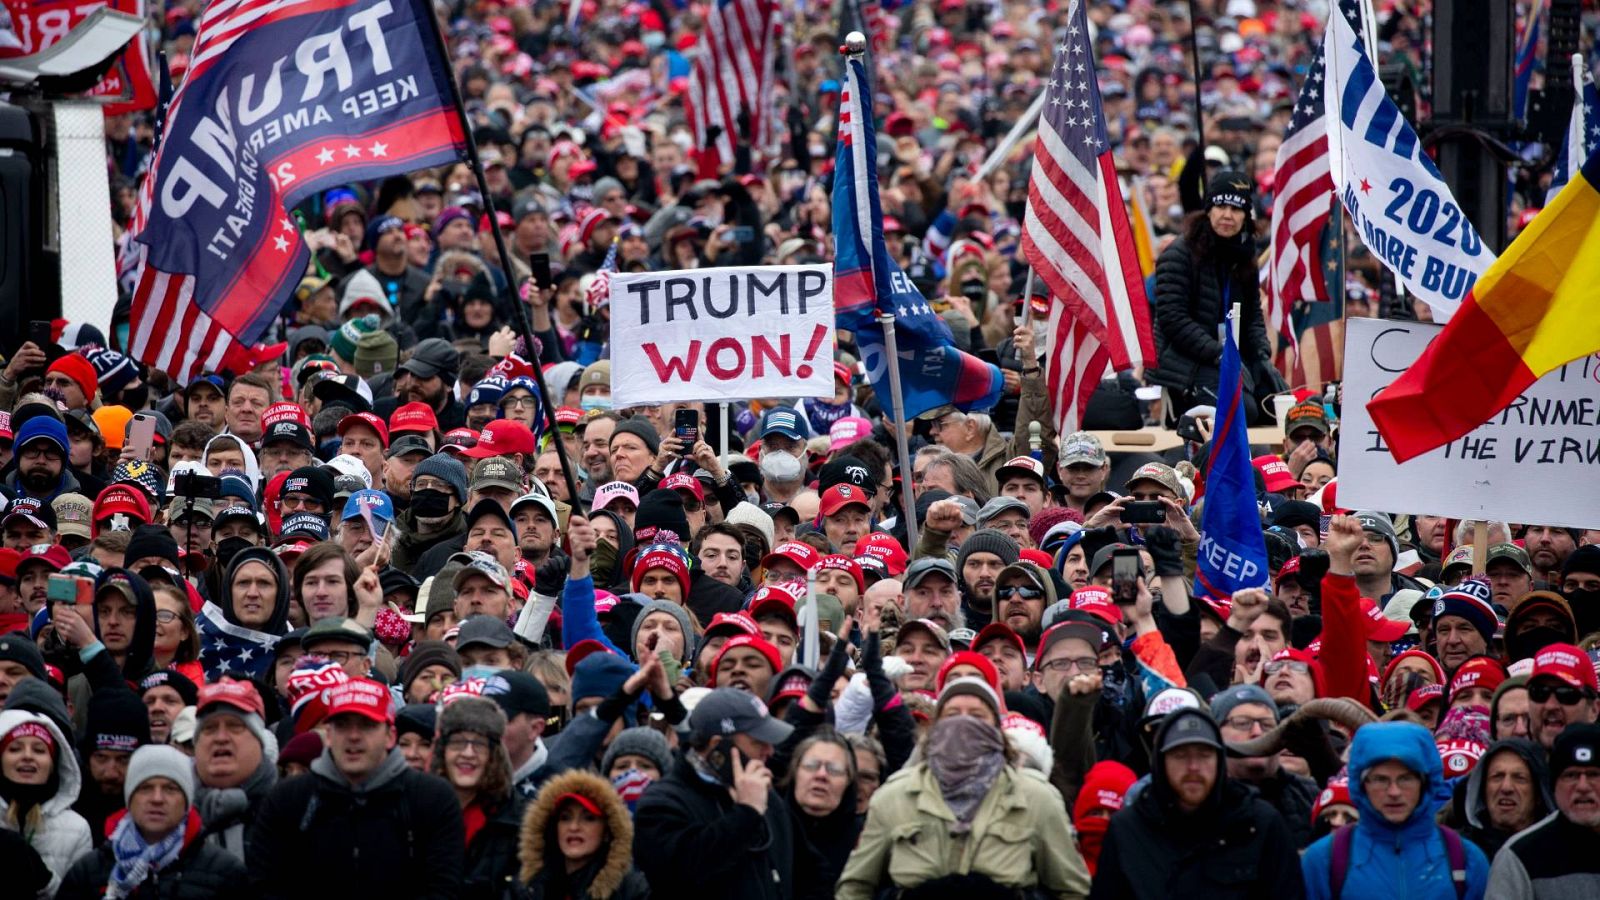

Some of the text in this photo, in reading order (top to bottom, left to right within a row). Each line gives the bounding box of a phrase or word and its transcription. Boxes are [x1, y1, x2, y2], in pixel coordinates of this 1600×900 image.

[1362, 212, 1418, 280] MORE
[628, 270, 826, 325] TRUMP
[641, 323, 828, 384] WON!
[601, 483, 635, 494] TRUMP
[12, 496, 42, 509] Trump
[296, 515, 326, 527] AMERICA
[302, 523, 323, 532] AGAIN
[865, 545, 893, 556] Trump
[1199, 530, 1259, 582] KEEP
